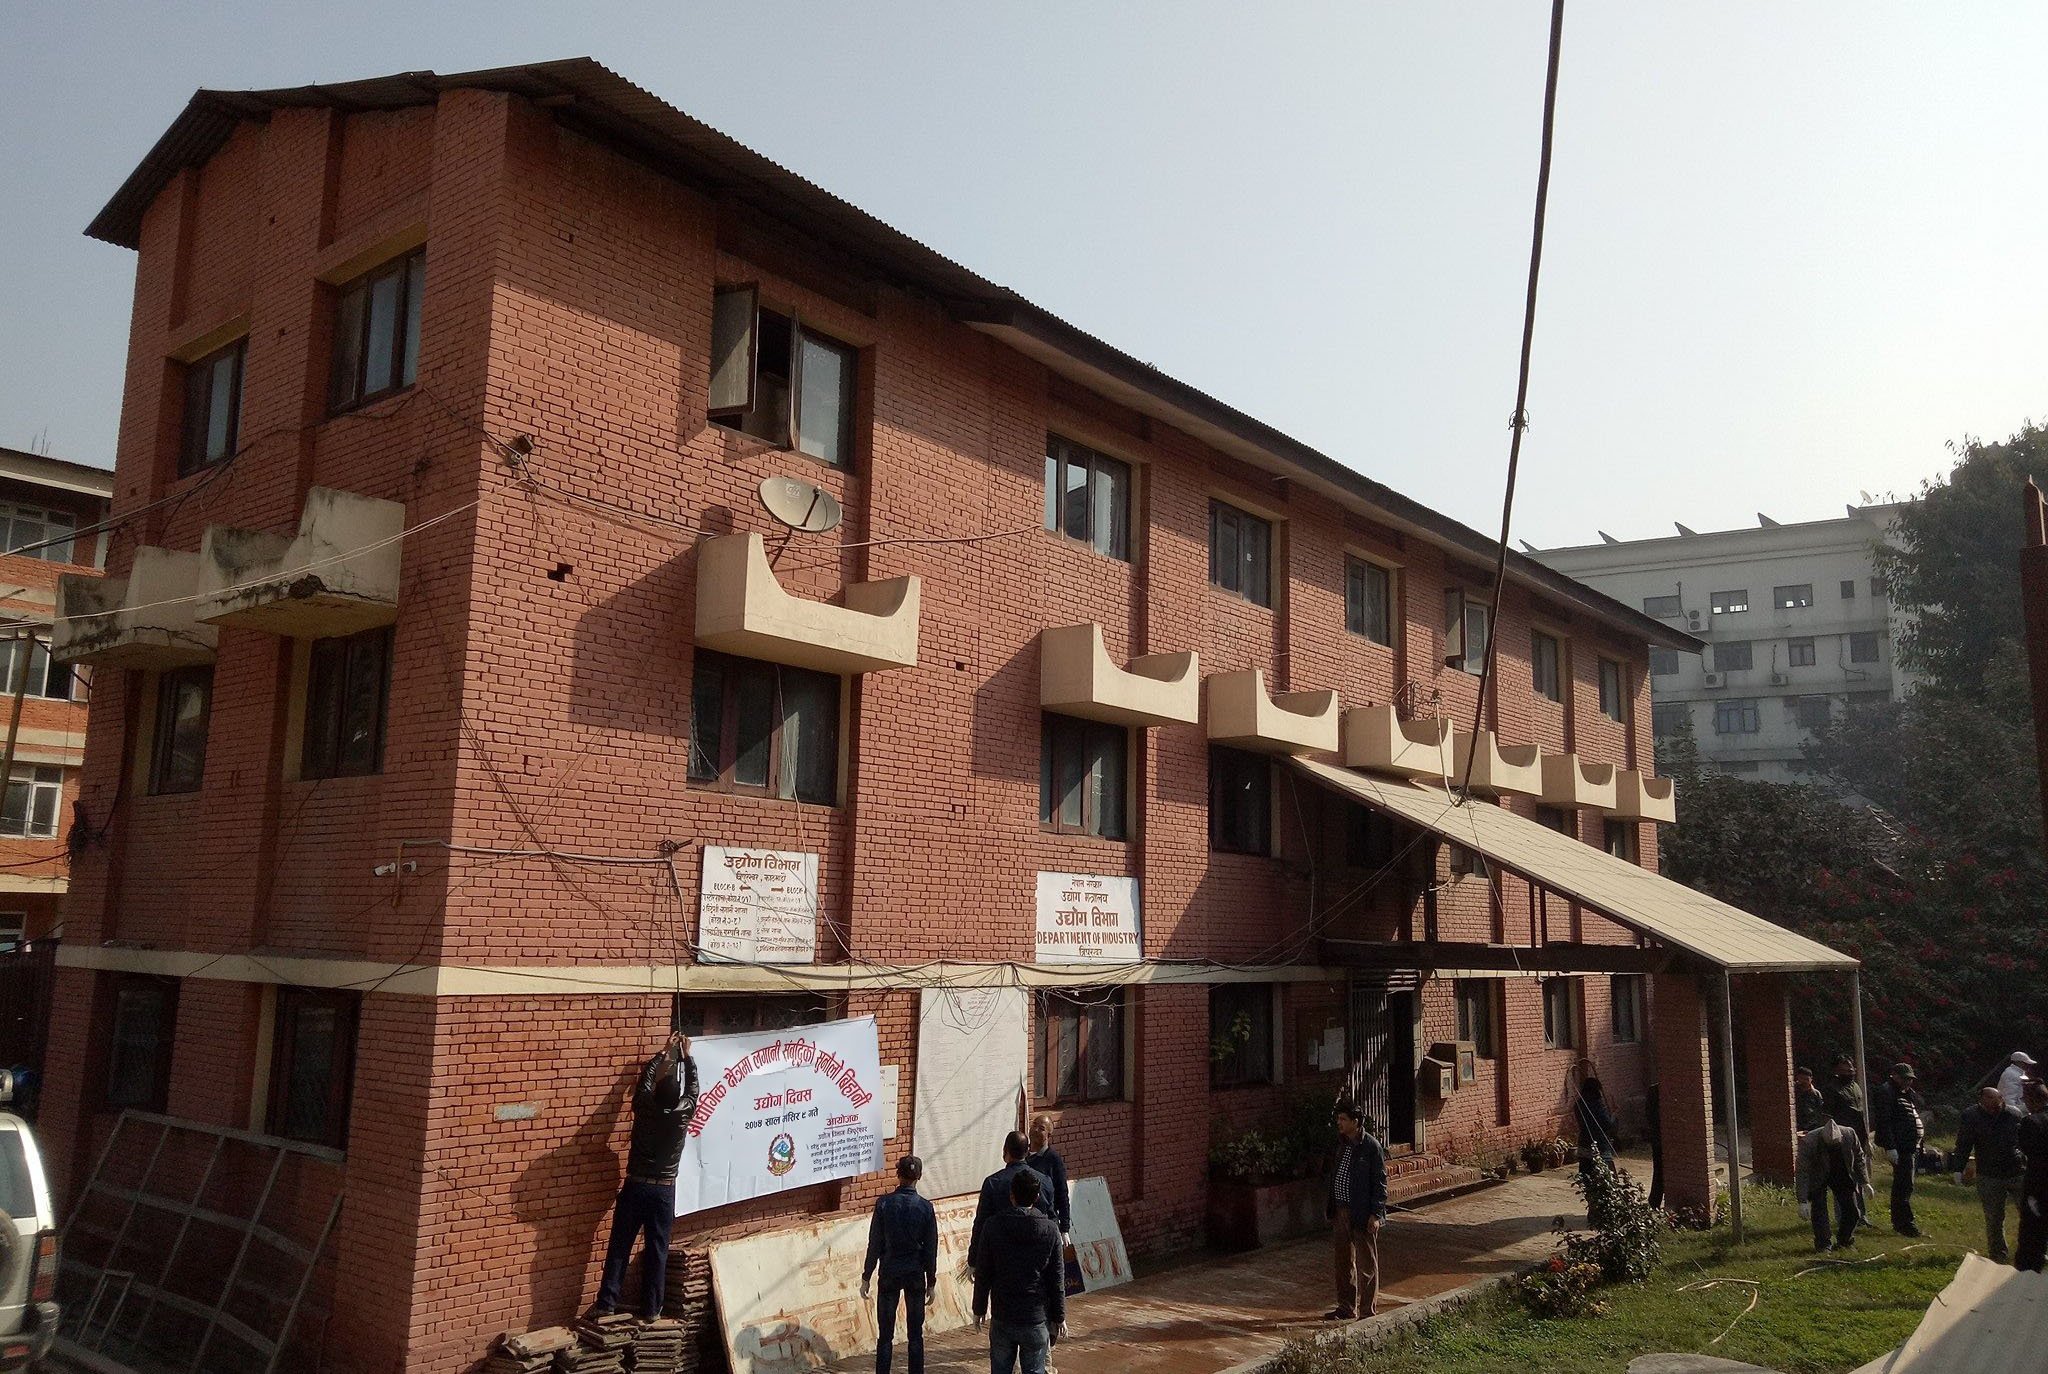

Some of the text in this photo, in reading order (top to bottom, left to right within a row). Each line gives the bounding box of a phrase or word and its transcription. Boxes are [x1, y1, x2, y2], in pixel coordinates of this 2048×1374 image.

[724, 852, 801, 871] उद्योग विभाग
[1071, 876, 1084, 887] नेपाल
[1062, 888, 1081, 902] उद्योग
[1056, 906, 1118, 927] उद्योग विभाग
[1037, 932, 1139, 945] DEPARTMENT OF INDUSTRY
[723, 1055, 753, 1088] क्षेत्रमा
[751, 1040, 781, 1070] लगानी
[836, 1068, 872, 1109] बिहानी
[754, 1089, 813, 1110] उद्योग दिवस
[765, 1116, 780, 1127] साल
[808, 1107, 819, 1118] गते
[826, 1114, 859, 1127] आयोजक
